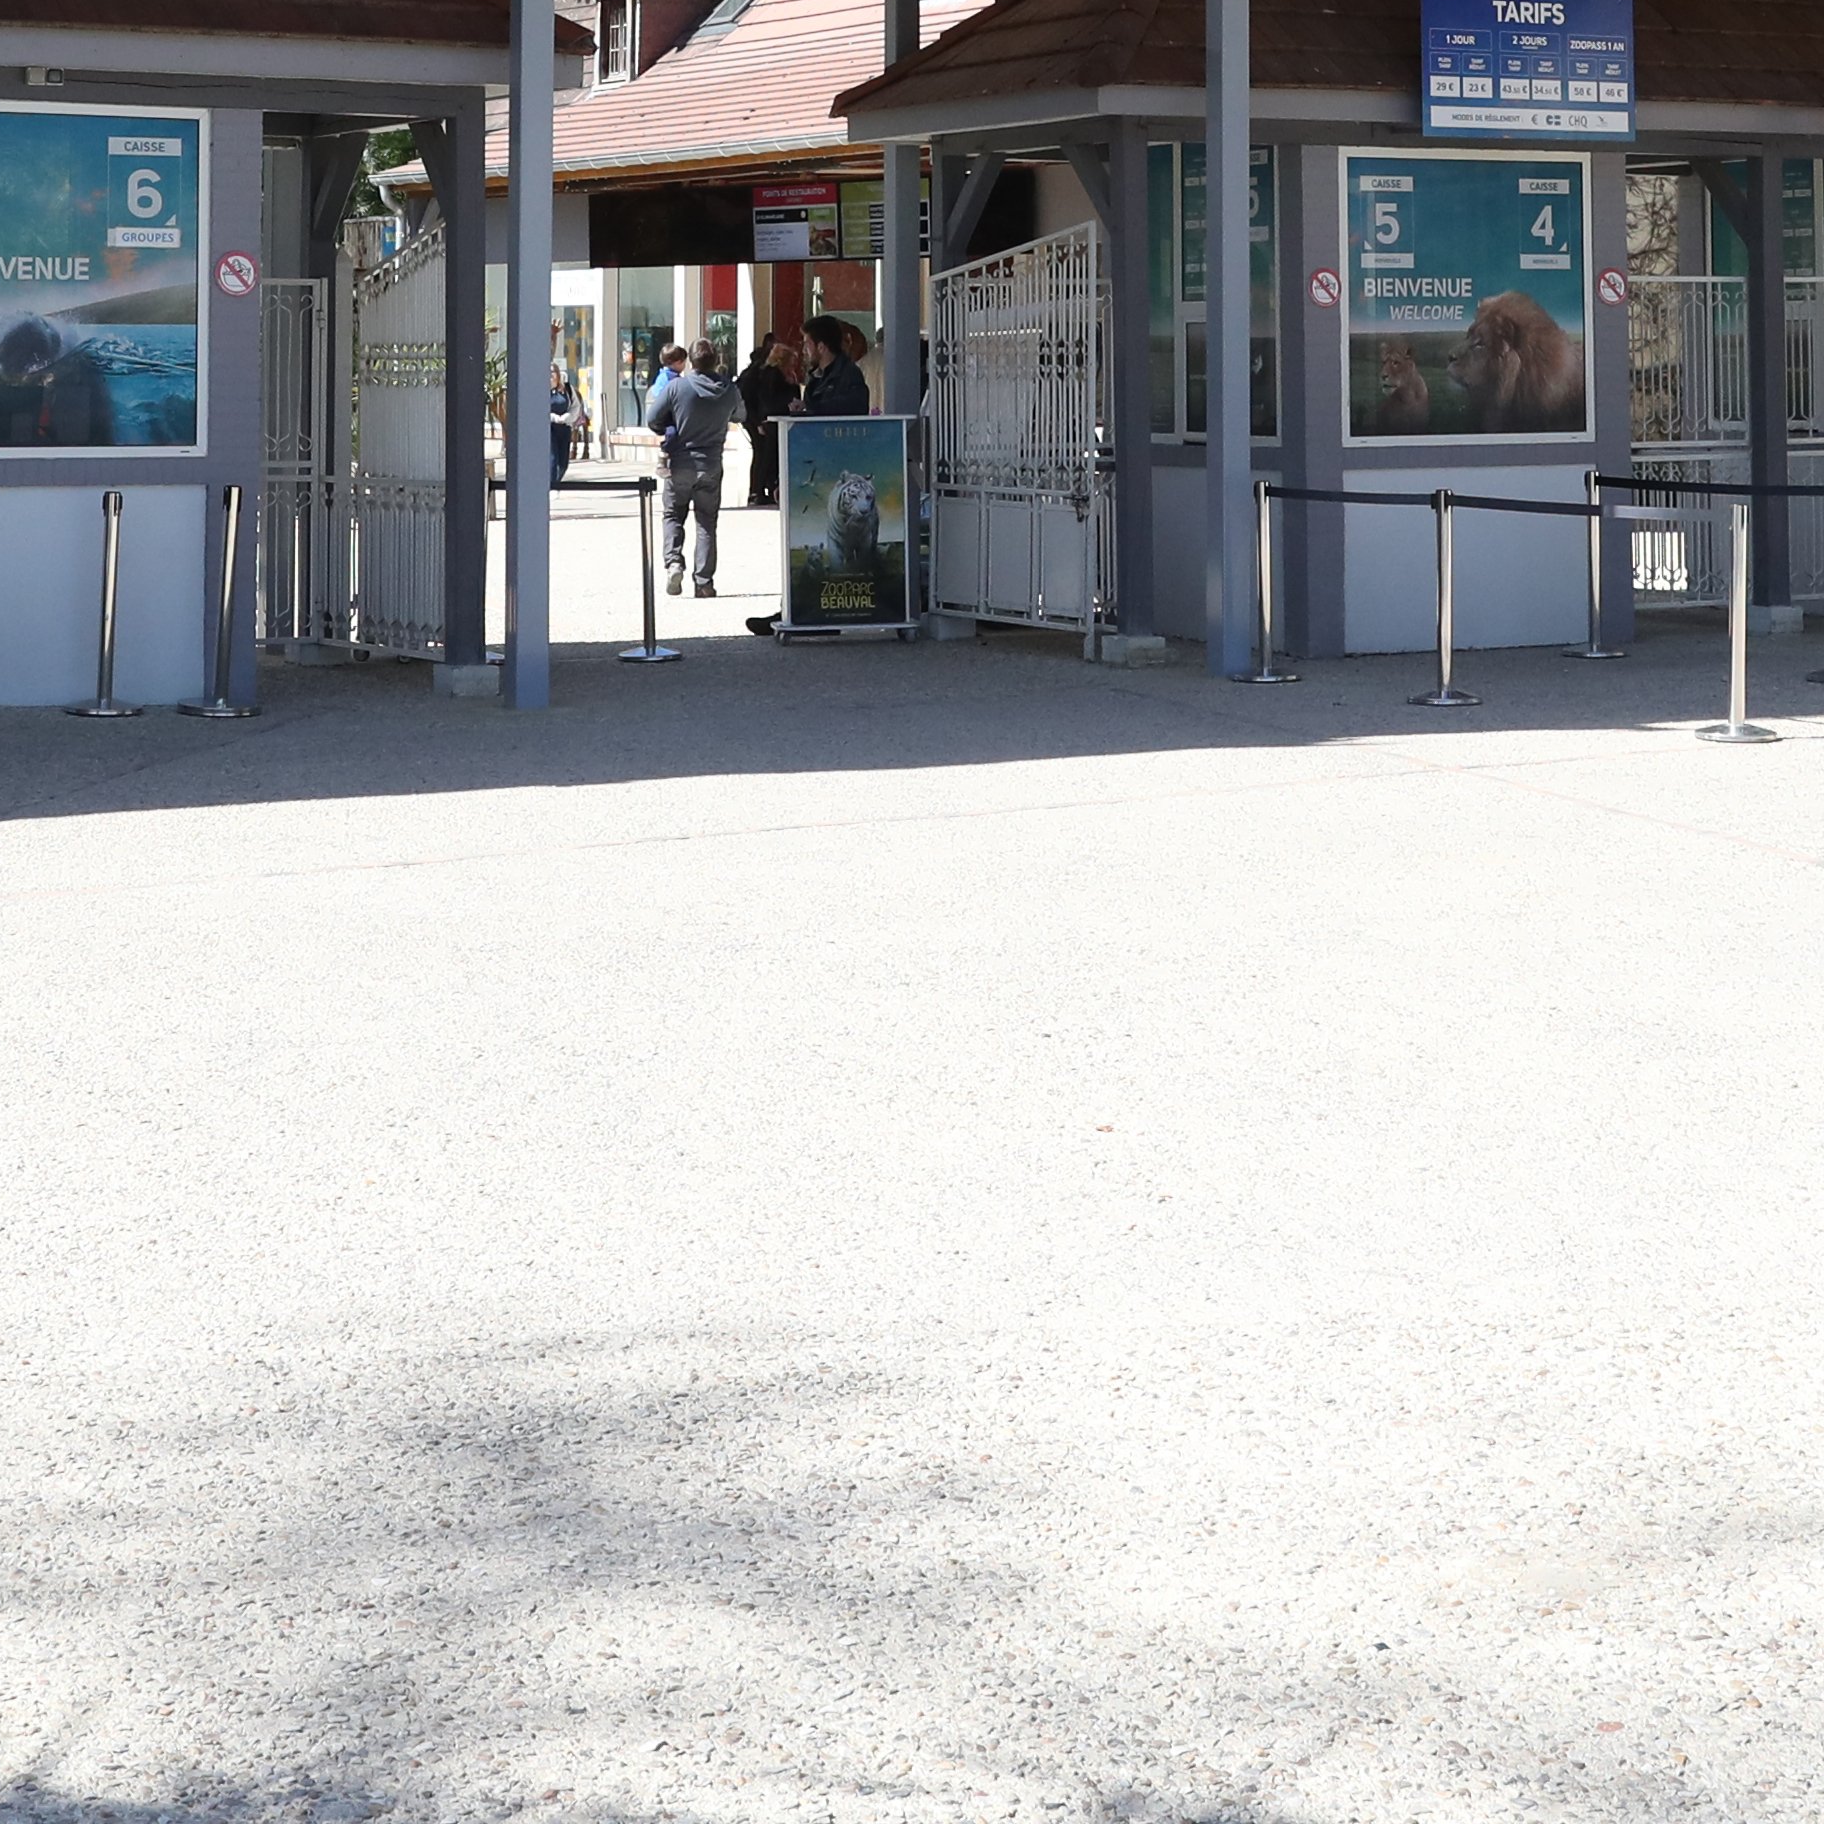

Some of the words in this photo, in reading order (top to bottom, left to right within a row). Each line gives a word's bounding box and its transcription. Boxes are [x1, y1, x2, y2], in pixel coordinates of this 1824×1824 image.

[1492, 0, 1565, 25] TARIFS
[1446, 35, 1450, 44] 1
[1451, 35, 1475, 46] JOUR
[1512, 35, 1518, 45] 2
[1519, 36, 1548, 47] JOURS
[1570, 39, 1606, 50] ZOOPASS
[1607, 41, 1611, 51] 1
[1612, 41, 1625, 52] AN
[1436, 81, 1447, 91] 29
[1448, 82, 1454, 91] €
[1469, 83, 1479, 92] 23
[1481, 83, 1486, 92] €
[1522, 85, 1528, 94] €
[1553, 86, 1559, 95] €
[1568, 115, 1588, 128] CHQ
[124, 140, 166, 153] CAISSE
[1371, 179, 1402, 189] CAISSE
[1529, 182, 1558, 191] CAISSE
[127, 168, 163, 219] 6
[1375, 203, 1400, 245] 5
[1530, 204, 1555, 246] 4
[122, 232, 174, 243] GROUPES
[1364, 277, 1473, 298] BIENVENUE
[1389, 304, 1465, 321] WELCOME
[820, 595, 876, 609] BEAUVAL
